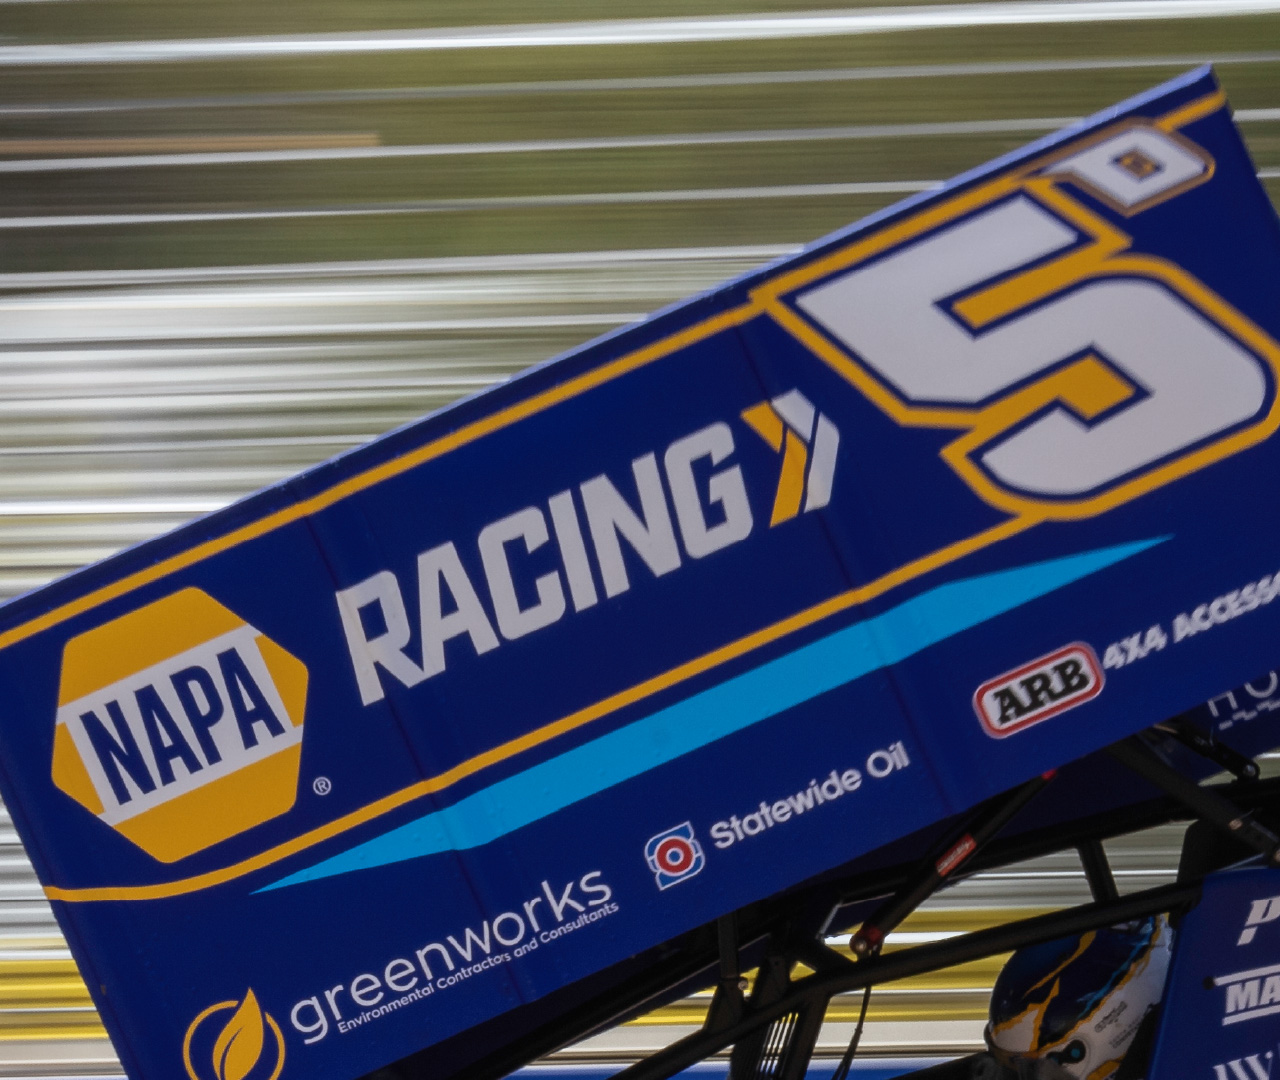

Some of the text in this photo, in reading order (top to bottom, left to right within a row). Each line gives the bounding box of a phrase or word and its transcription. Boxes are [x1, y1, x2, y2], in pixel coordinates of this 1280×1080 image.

[795, 194, 1266, 495] 5
[335, 421, 754, 707] RACING
[80, 646, 286, 806] NAPA
[991, 657, 1092, 727] ARB
[1102, 623, 1169, 672] 4X4
[710, 740, 911, 851] Statewide Oil
[290, 870, 613, 1046] greenworks
[337, 901, 619, 1035] Environmental Contractors and Consultants
